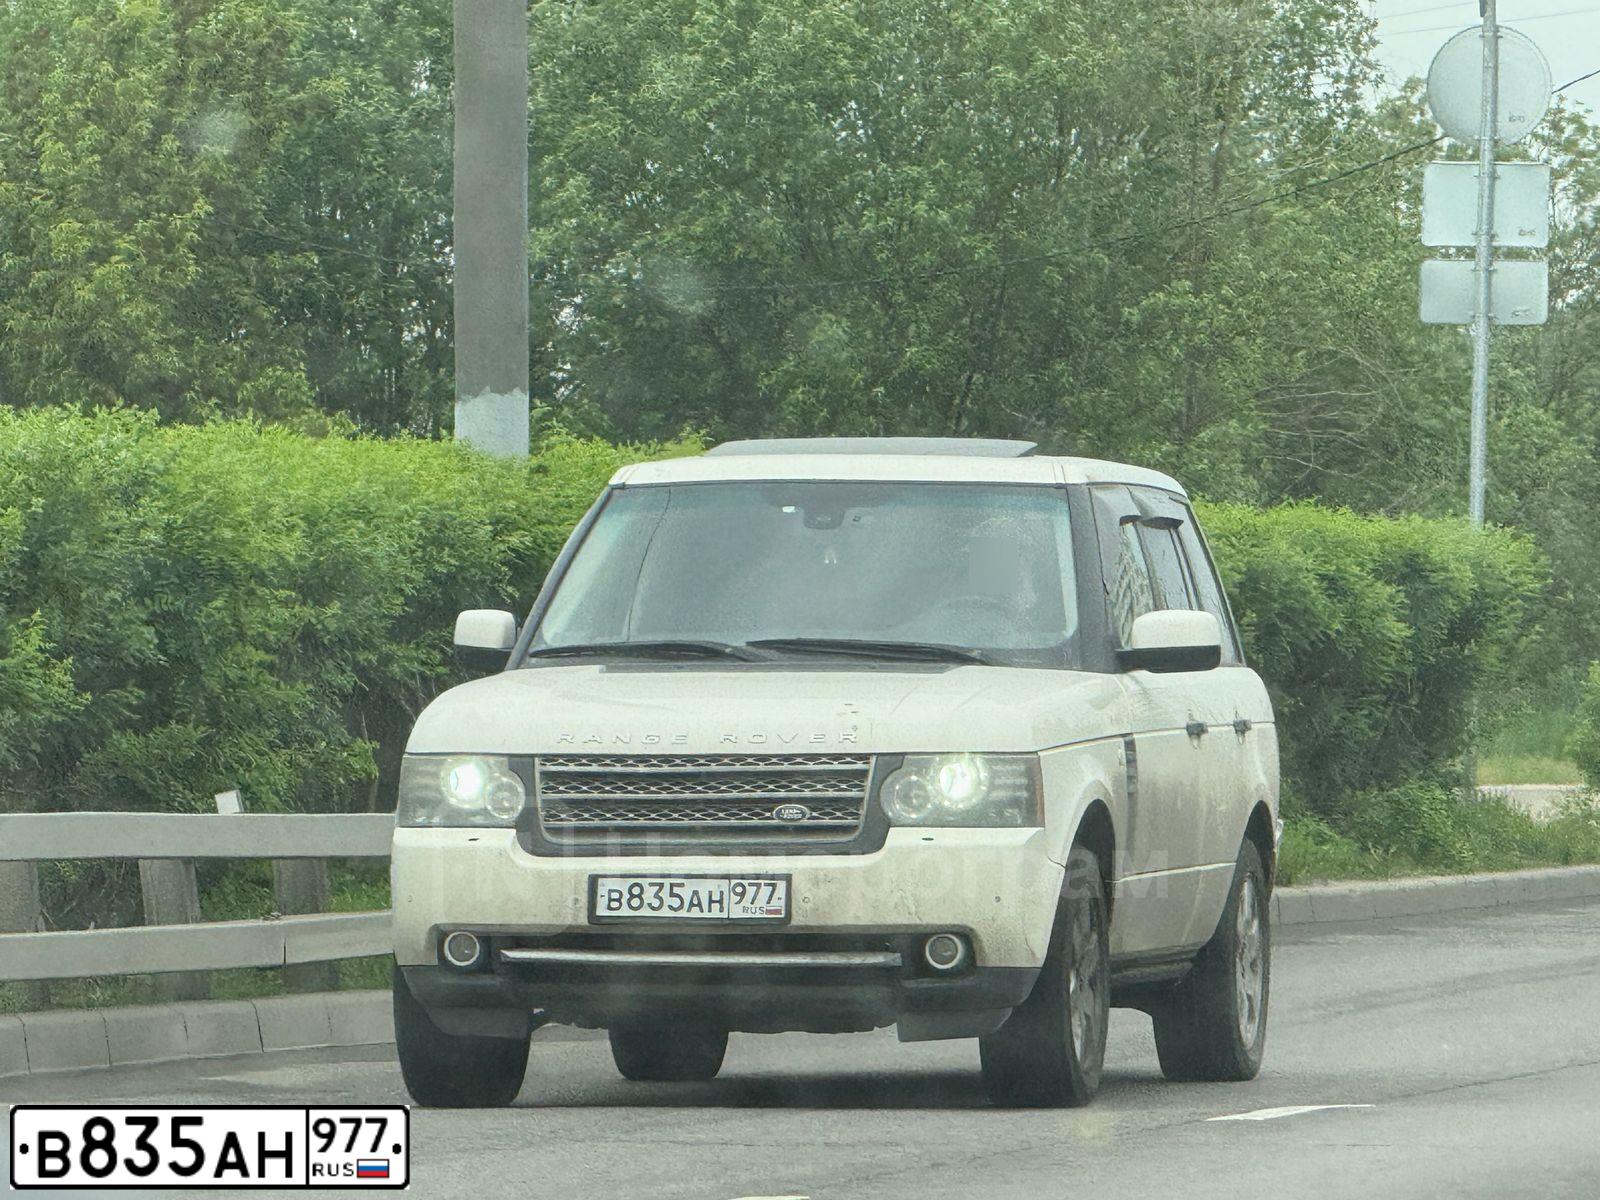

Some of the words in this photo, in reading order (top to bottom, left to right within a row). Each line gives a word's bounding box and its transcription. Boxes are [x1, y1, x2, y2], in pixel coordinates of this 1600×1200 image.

[556, 733, 689, 745] RANGE
[720, 732, 858, 745] ROVER
[606, 882, 725, 914] В835АН
[731, 882, 778, 905] 977
[742, 906, 765, 915] RUS
